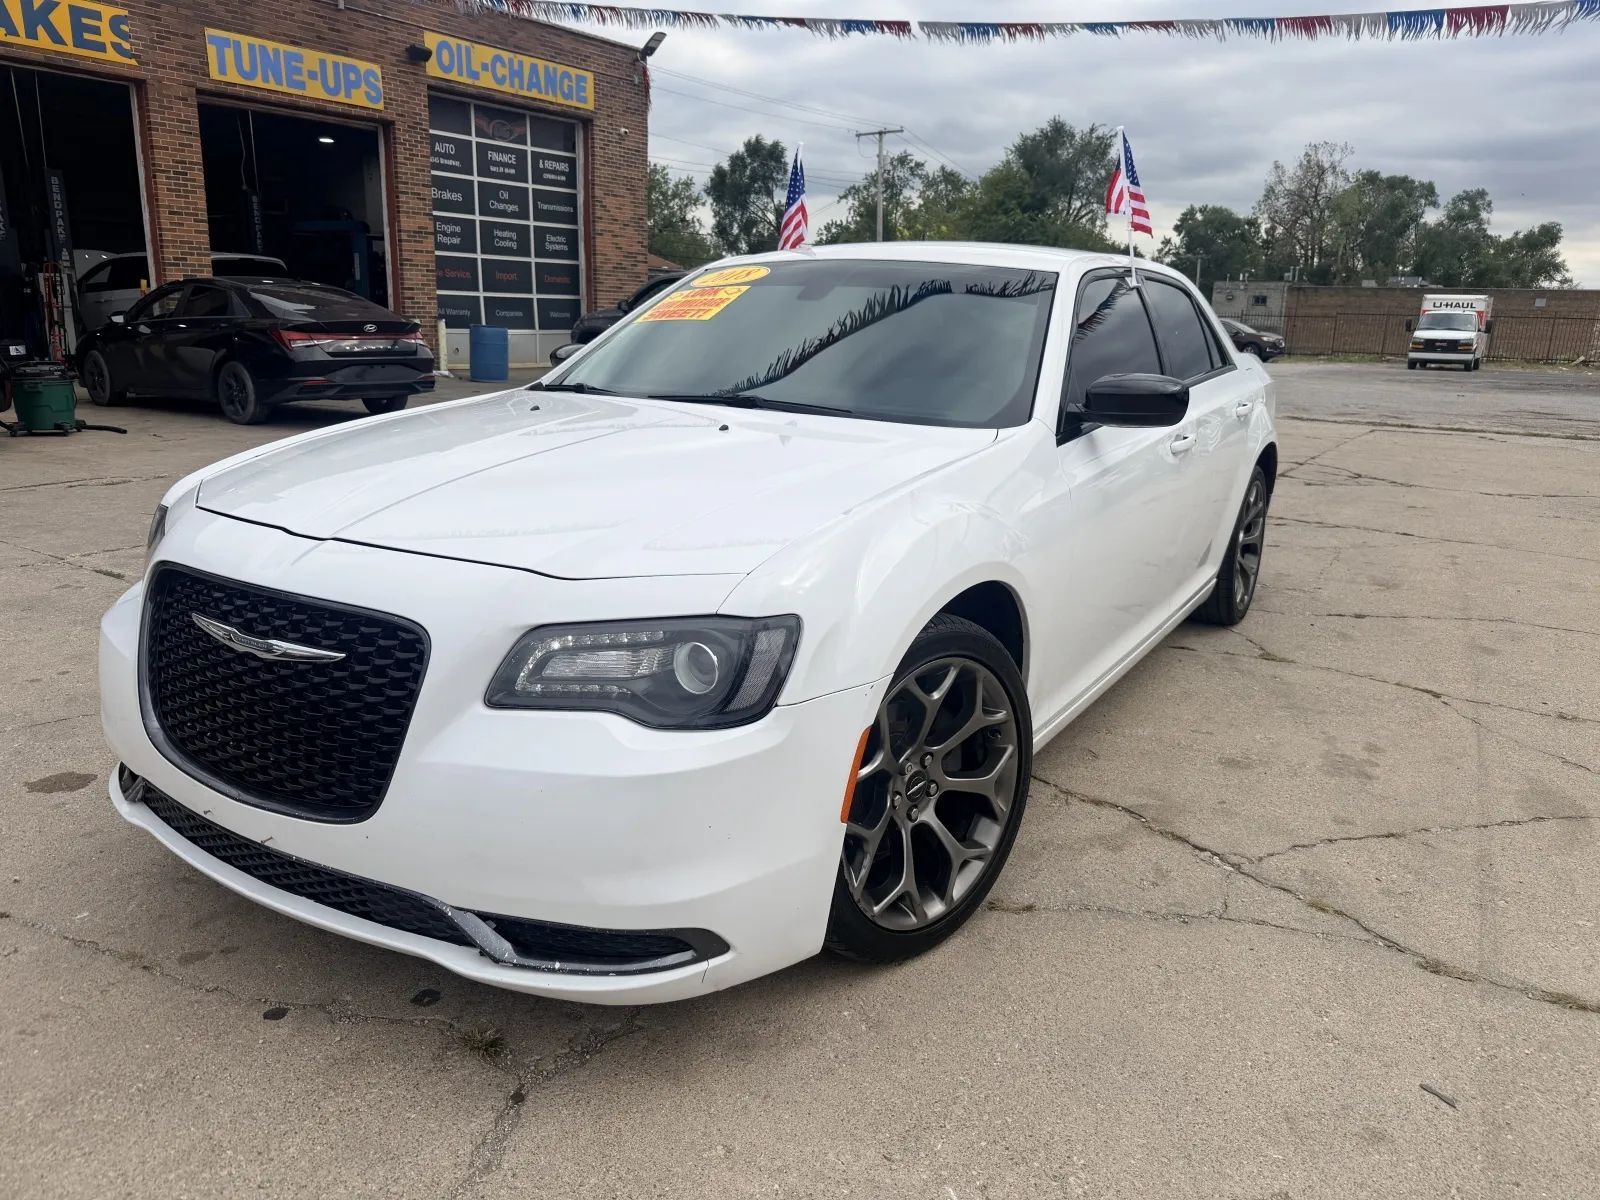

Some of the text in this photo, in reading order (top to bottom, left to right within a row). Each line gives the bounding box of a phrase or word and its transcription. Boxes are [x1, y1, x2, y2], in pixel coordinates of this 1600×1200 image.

[207, 34, 383, 105] TUNE-UPS
[435, 40, 588, 104] OIL-CHANGE
[434, 142, 456, 155] AUTO
[487, 150, 517, 165] FINANCE
[538, 159, 570, 172] & REPAIRS
[431, 187, 463, 202] Brakes
[499, 190, 509, 200] Oil
[489, 200, 519, 213] Changes
[537, 201, 574, 213] Transmissions
[436, 221, 461, 233] Engine
[437, 234, 461, 246] Repair
[493, 229, 517, 240] Heating
[546, 234, 567, 243] Electric
[494, 239, 517, 250] Cooling
[545, 242, 568, 252] Systems
[1433, 301, 1477, 309] U-HAUL
[446, 307, 471, 318] Warranty
